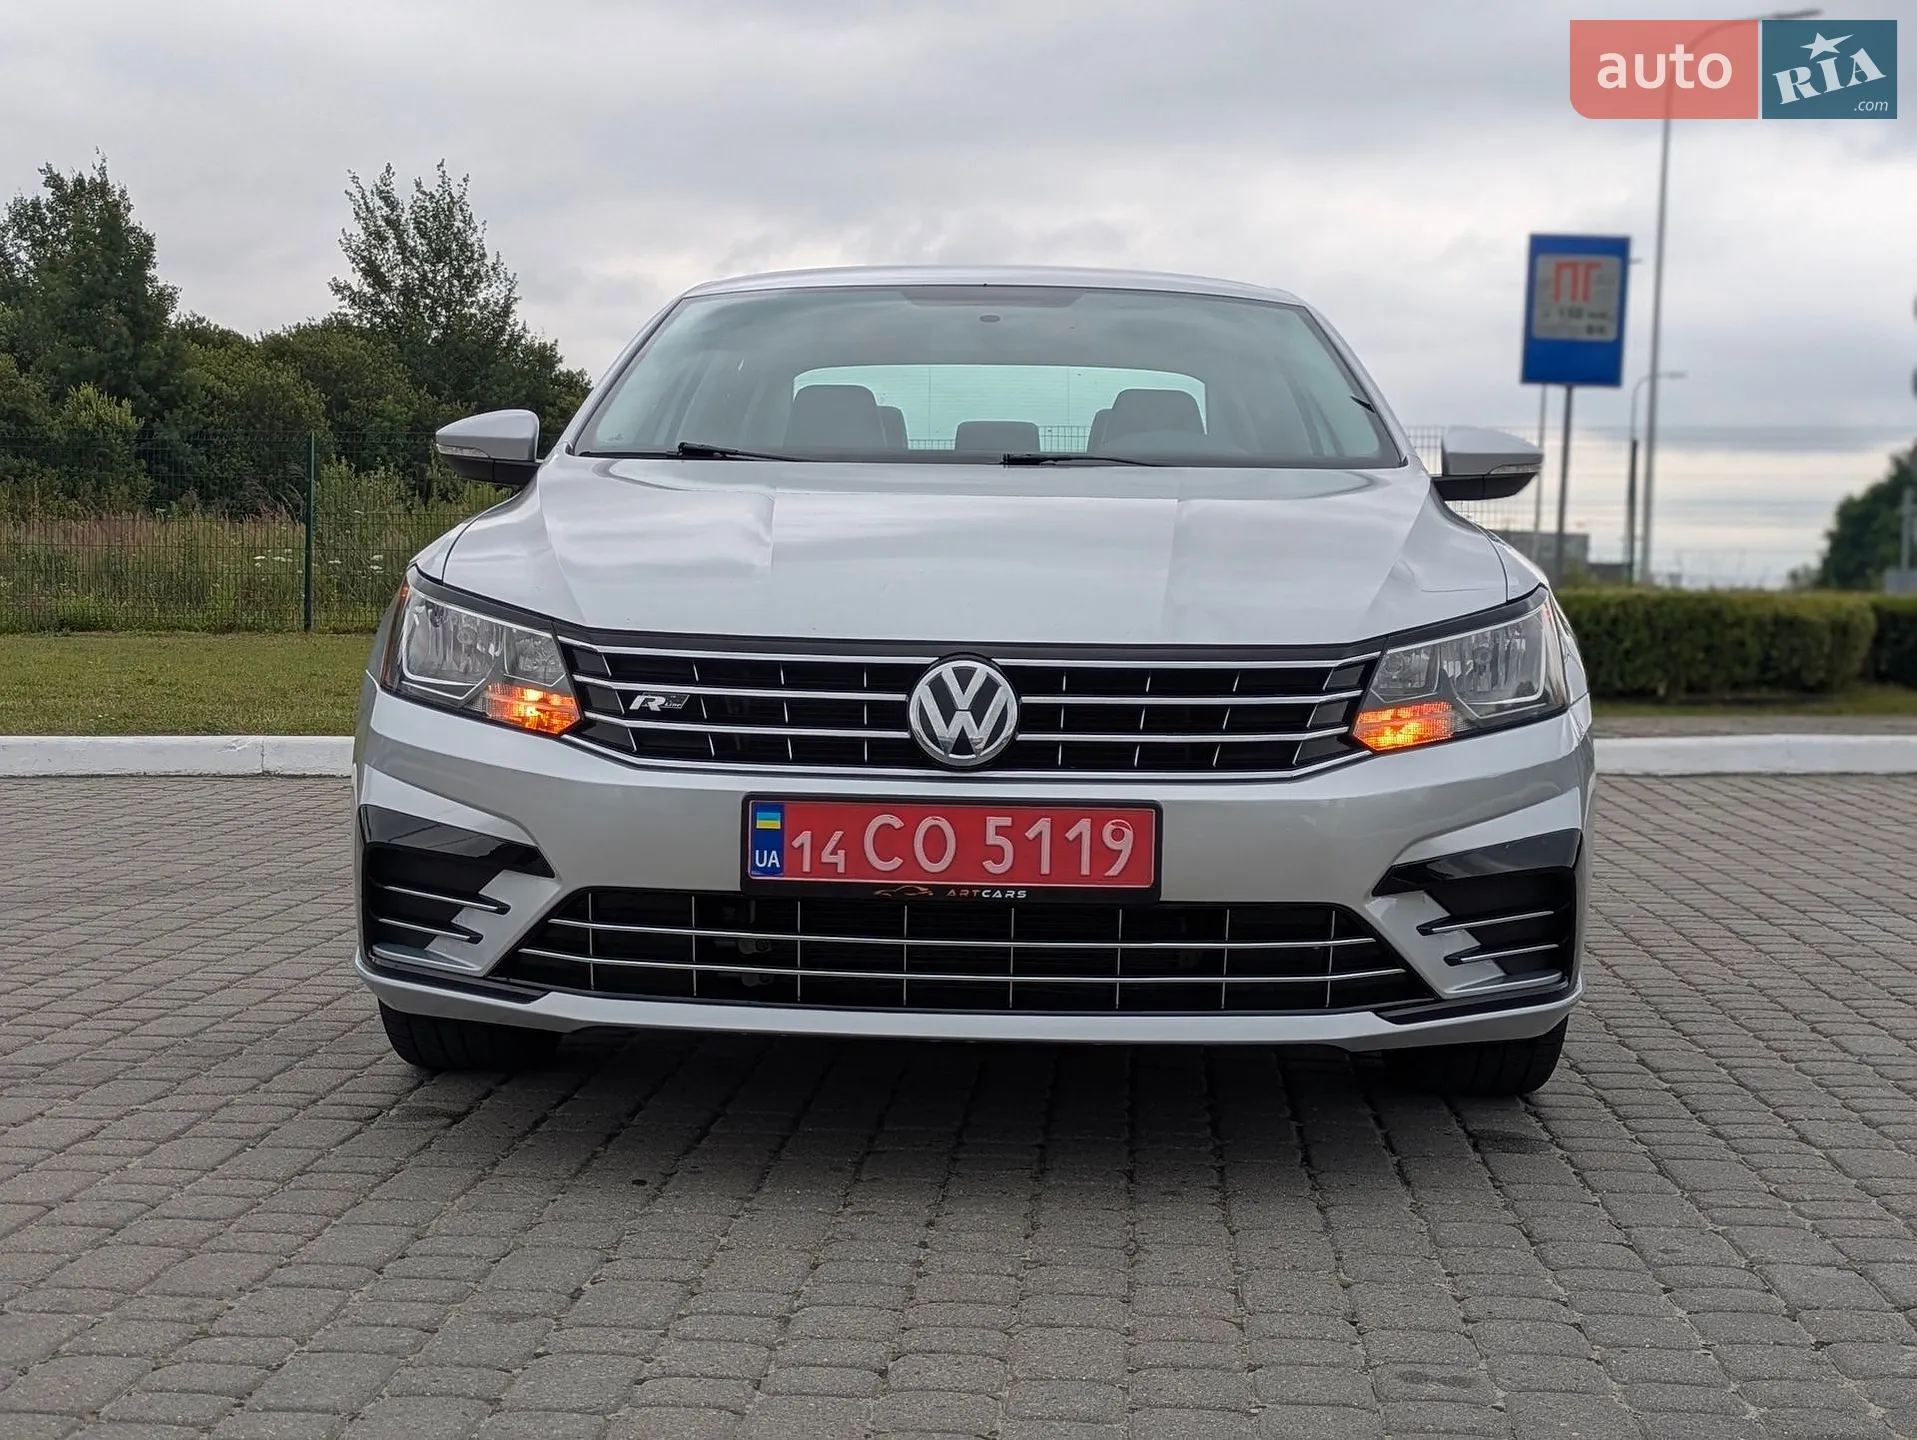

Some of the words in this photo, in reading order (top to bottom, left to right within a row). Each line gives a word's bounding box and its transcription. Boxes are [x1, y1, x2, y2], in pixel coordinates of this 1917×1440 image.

[1554, 260, 1603, 303] ПГ
[755, 849, 781, 869] UA
[791, 830, 846, 874] 14
[863, 813, 957, 874] CO
[982, 815, 1135, 877] 5119
